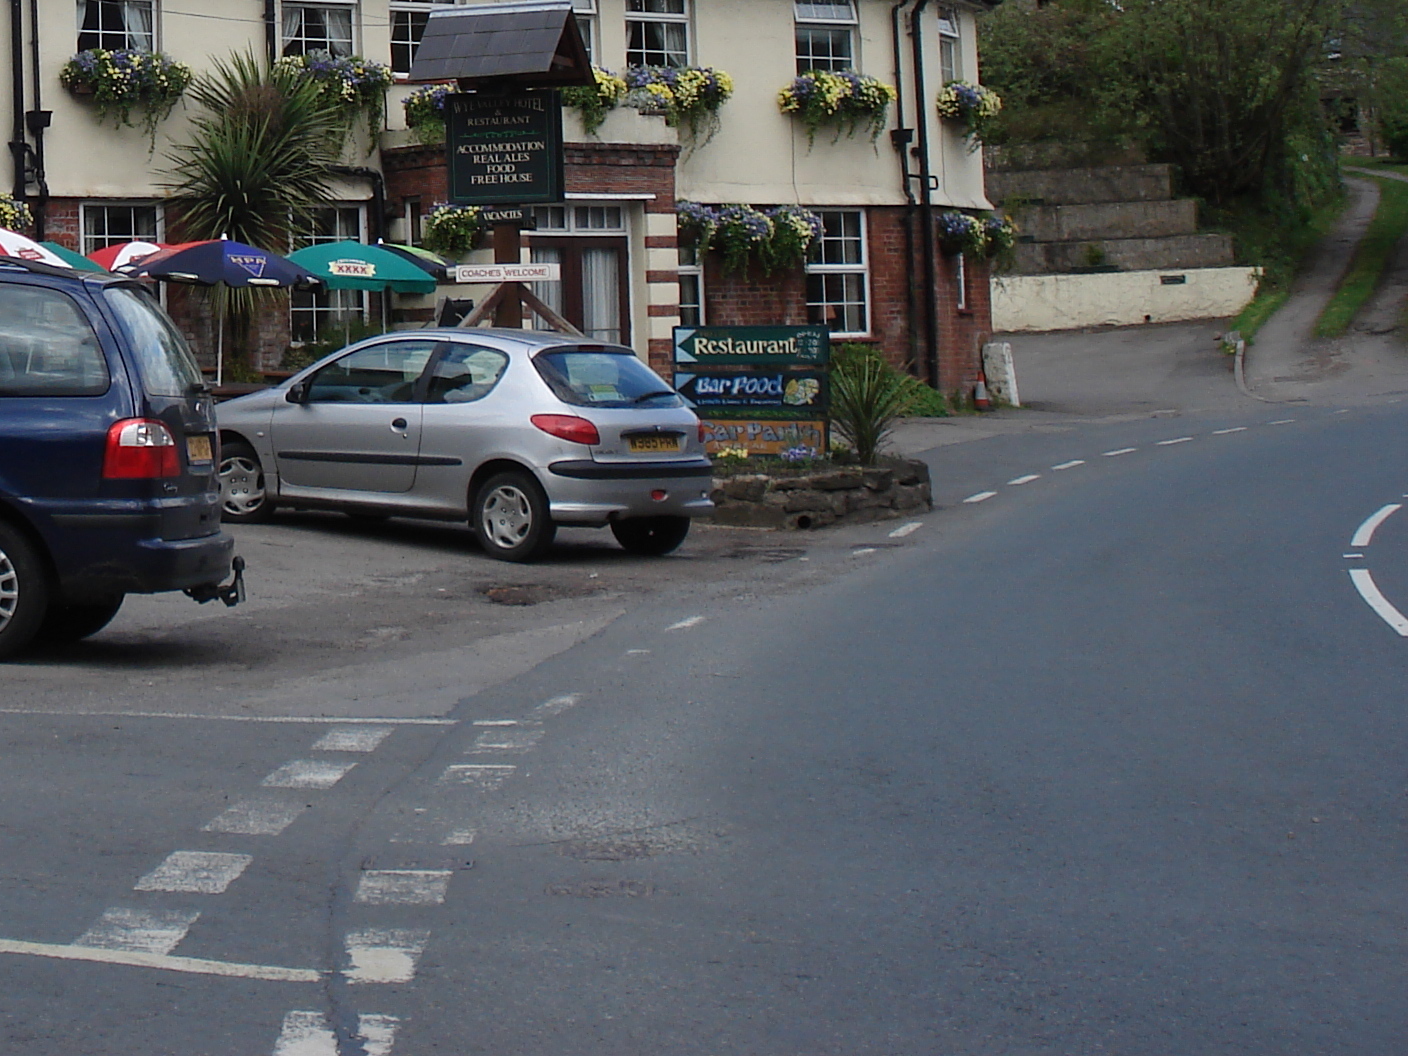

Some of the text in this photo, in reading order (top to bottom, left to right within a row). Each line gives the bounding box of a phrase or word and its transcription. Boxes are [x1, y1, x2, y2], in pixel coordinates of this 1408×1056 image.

[453, 97, 545, 114] WYE VALLEY HOTEL
[467, 115, 530, 127] RESTAURANT
[456, 140, 545, 154] ACCOMMODATION
[473, 152, 530, 164] REAL ALES
[486, 164, 516, 174] FOOD
[471, 173, 533, 185] FREE HOUSE
[337, 264, 367, 274] XXXX
[461, 267, 547, 278] COACHES WELCOME
[694, 337, 798, 355] Restaurant
[703, 421, 745, 443] Car
